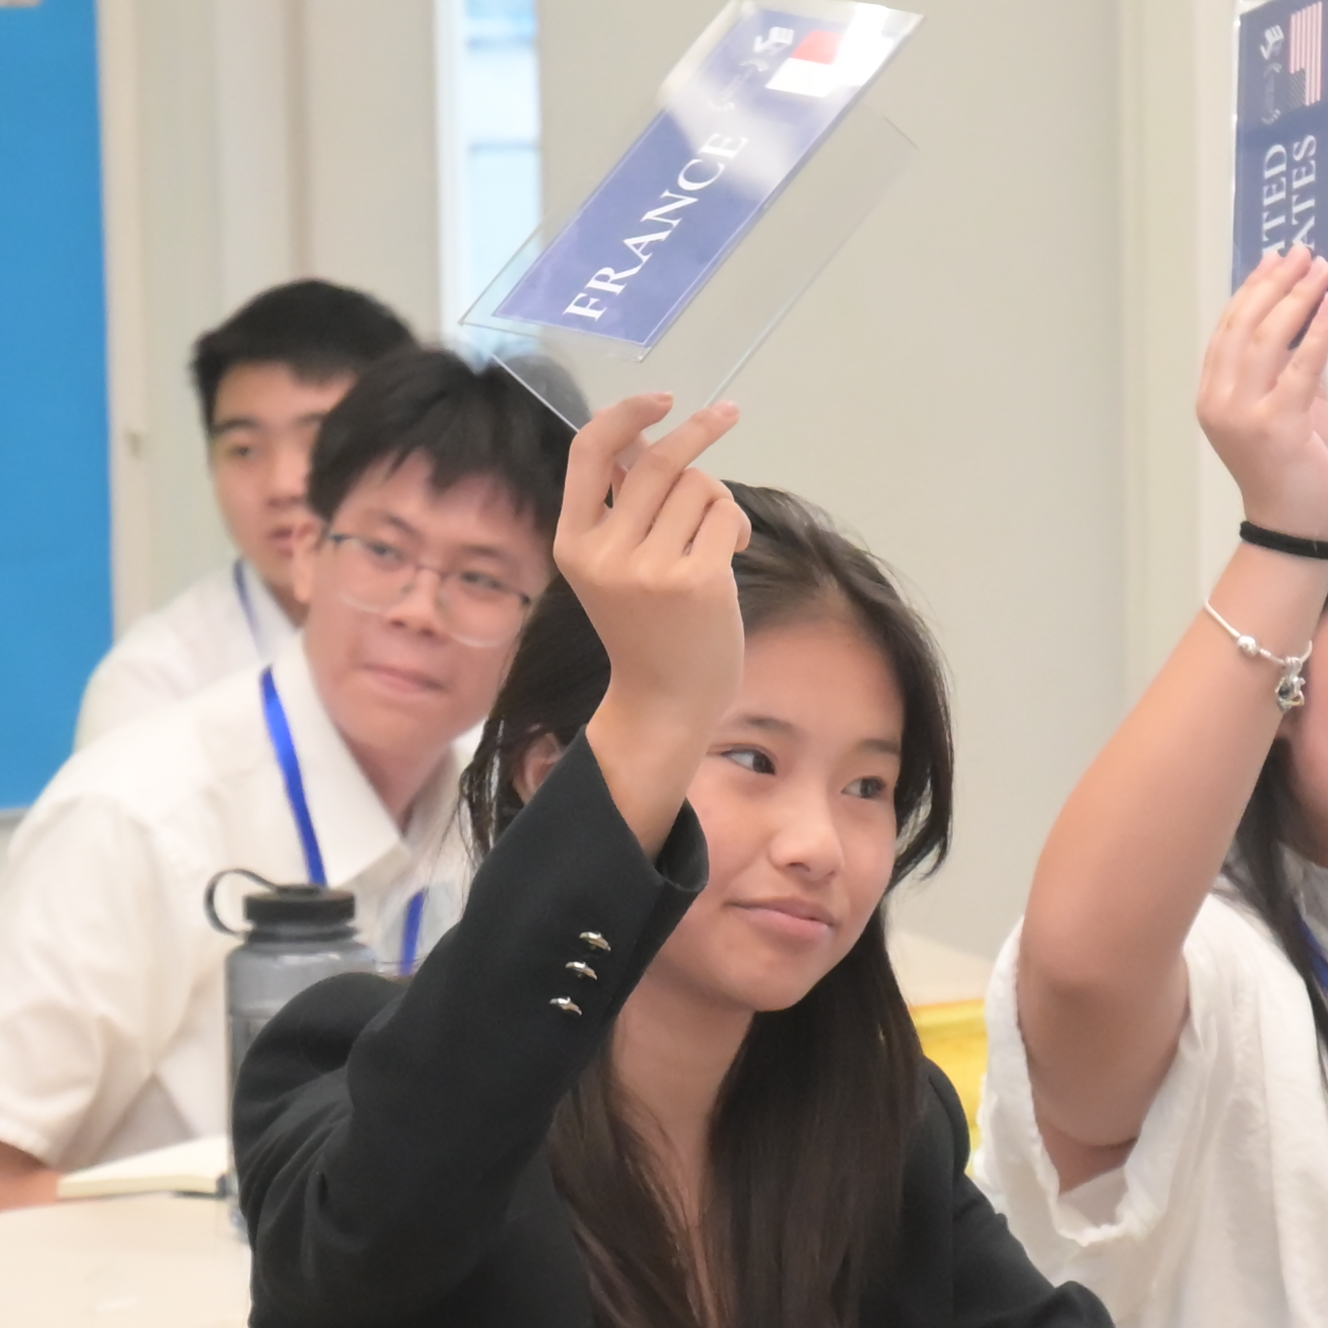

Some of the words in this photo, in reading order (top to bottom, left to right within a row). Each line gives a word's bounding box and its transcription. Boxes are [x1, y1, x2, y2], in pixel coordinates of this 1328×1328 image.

[563, 132, 749, 322] FRANCE
[1262, 143, 1288, 255] ITED
[1291, 134, 1318, 251] ATES
